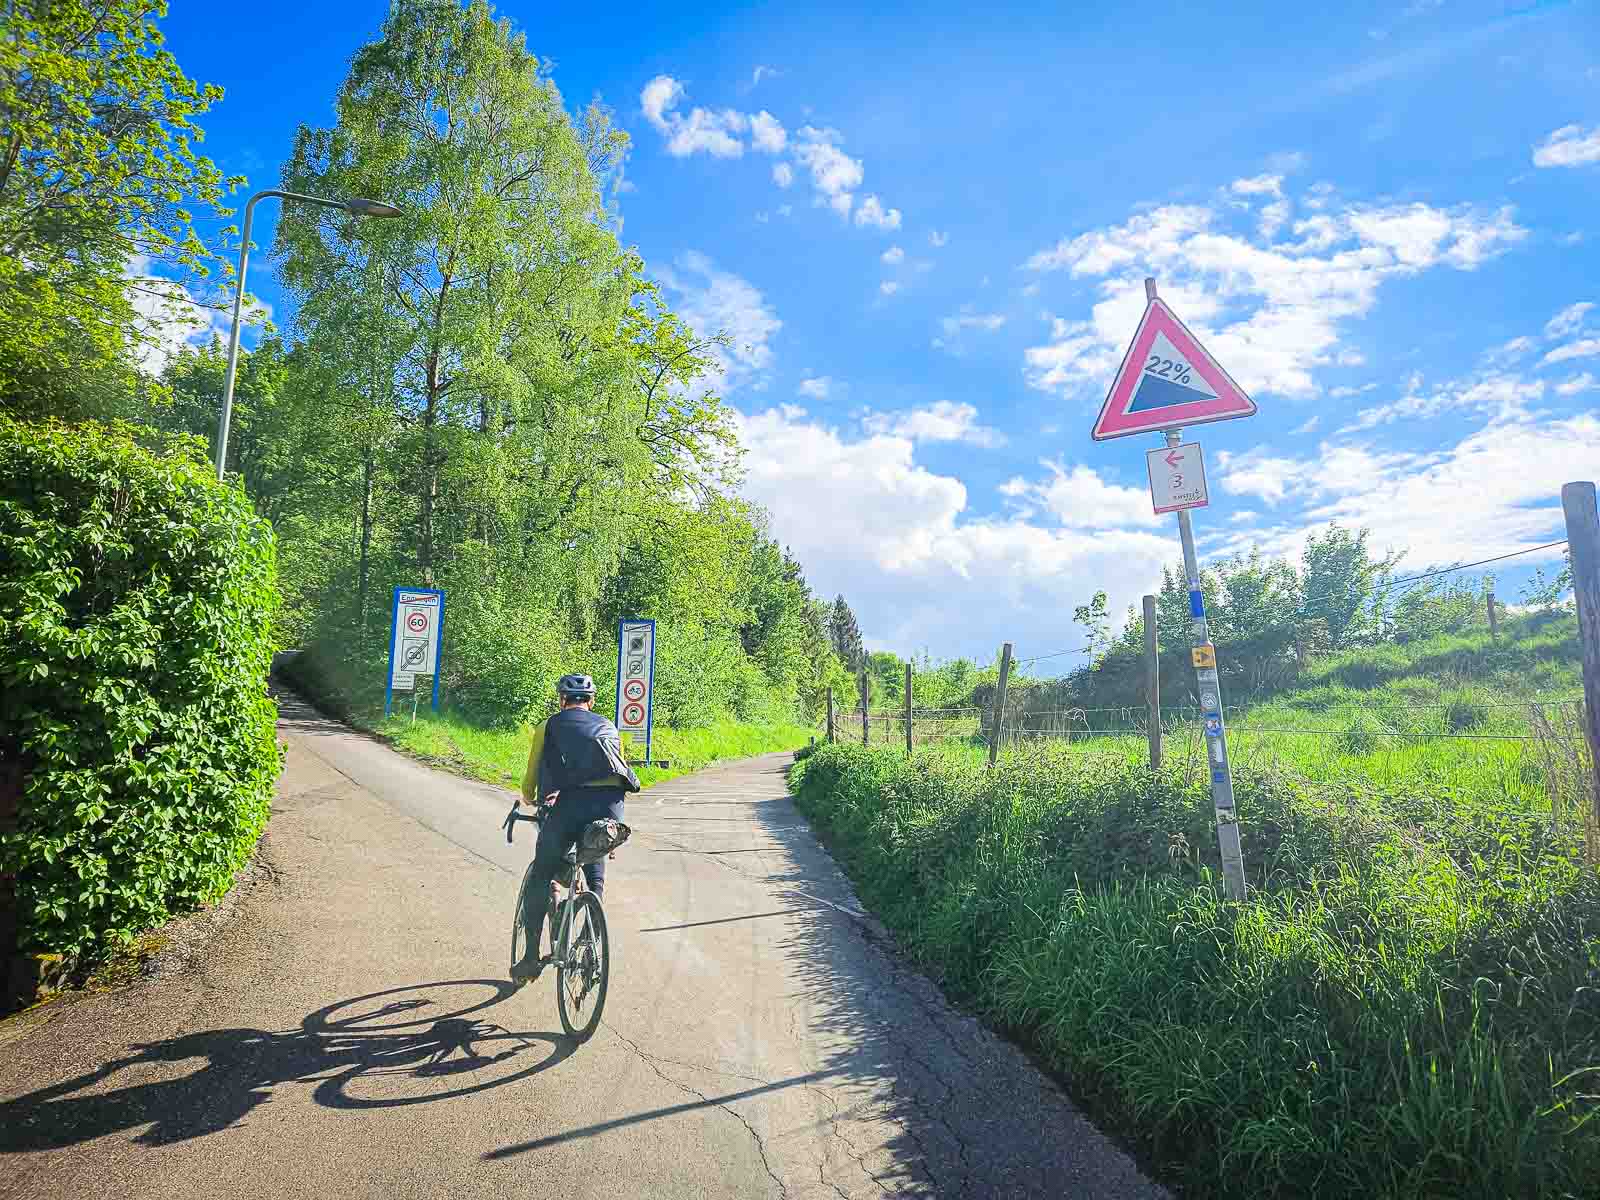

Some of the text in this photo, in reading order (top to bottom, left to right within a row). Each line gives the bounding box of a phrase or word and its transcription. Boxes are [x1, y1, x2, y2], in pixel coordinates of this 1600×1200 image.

[1144, 355, 1191, 385] 22%
[1173, 473, 1183, 489] 3
[410, 618, 424, 627] 60
